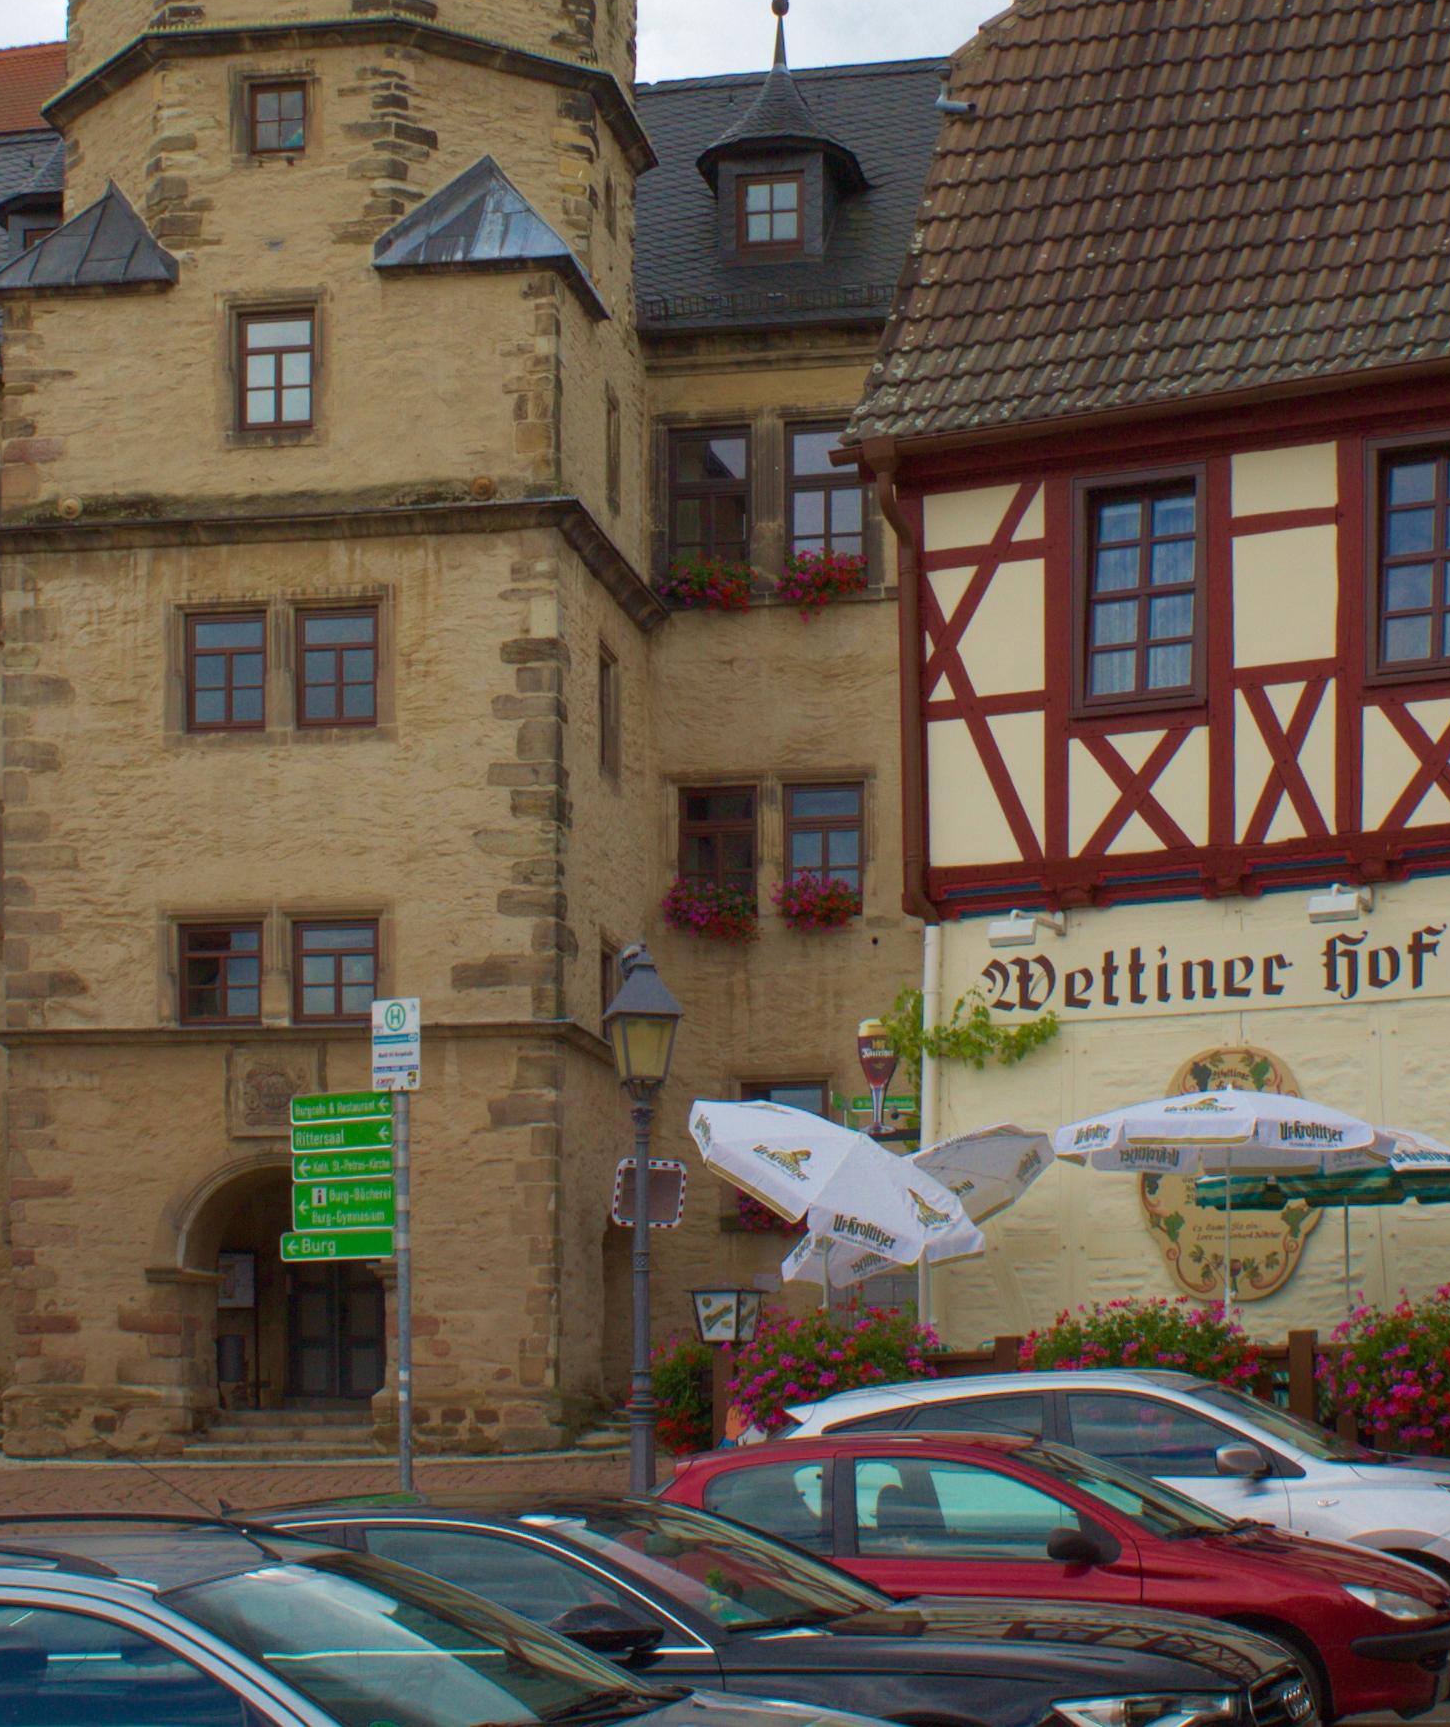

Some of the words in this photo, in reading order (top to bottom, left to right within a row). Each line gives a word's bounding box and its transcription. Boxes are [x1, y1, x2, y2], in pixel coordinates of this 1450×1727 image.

[980, 944, 1294, 1011] Wettiner
[1320, 922, 1447, 1000] Hof
[296, 1128, 345, 1147] Rittersaal
[302, 1238, 336, 1257] Burg
